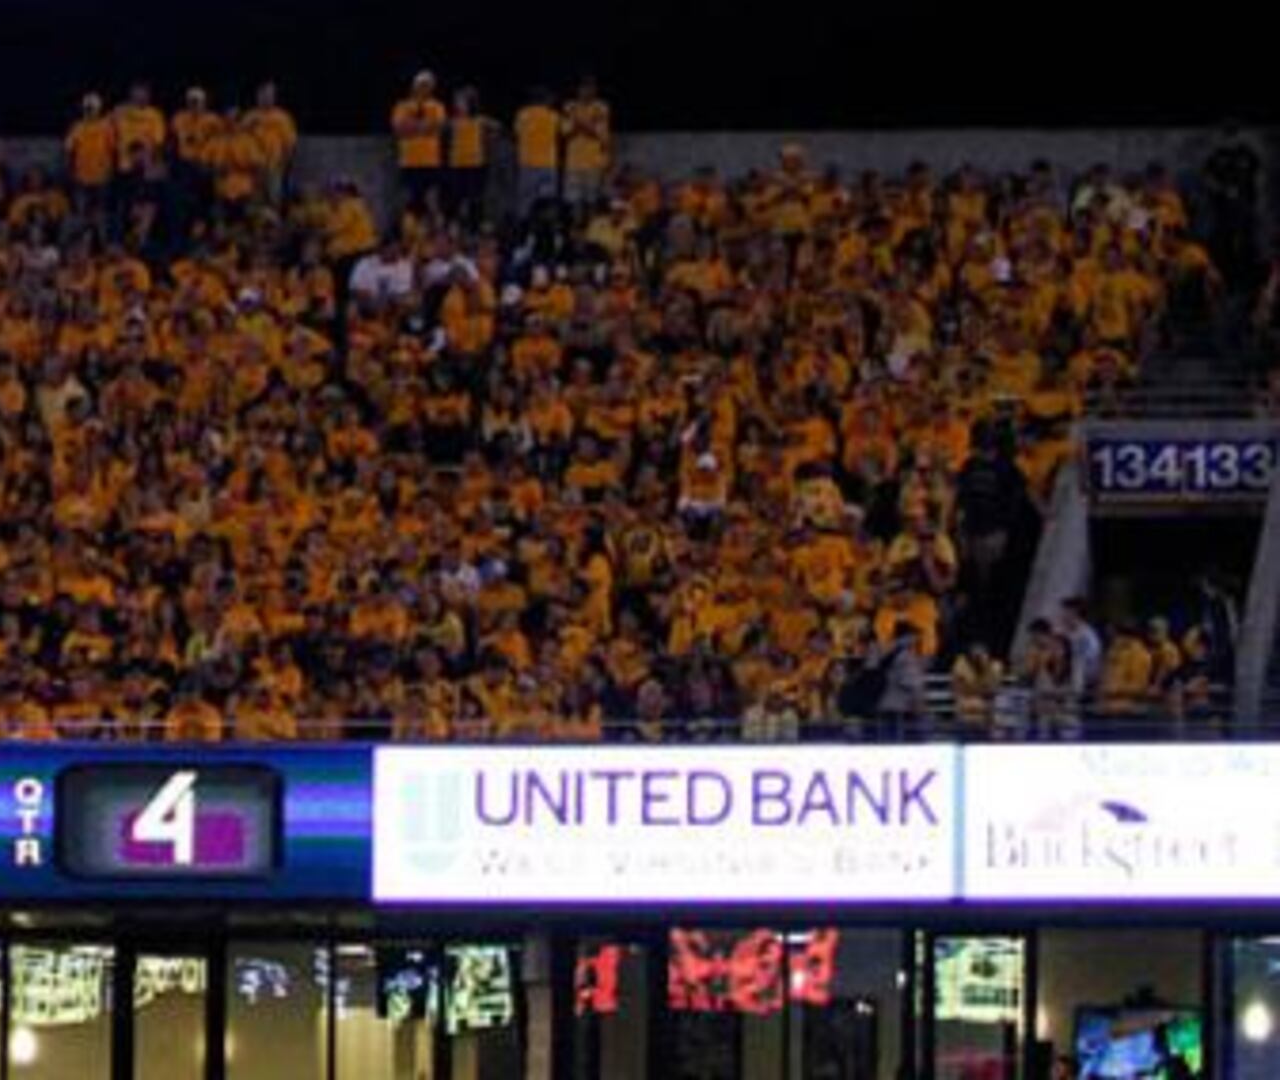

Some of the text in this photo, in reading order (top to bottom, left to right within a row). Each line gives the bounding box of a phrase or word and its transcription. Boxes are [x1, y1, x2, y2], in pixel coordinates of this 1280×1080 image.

[1092, 444, 1183, 488] 134
[1184, 443, 1273, 489] 133
[131, 769, 198, 865] 4
[474, 770, 940, 827] UNITED BANK
